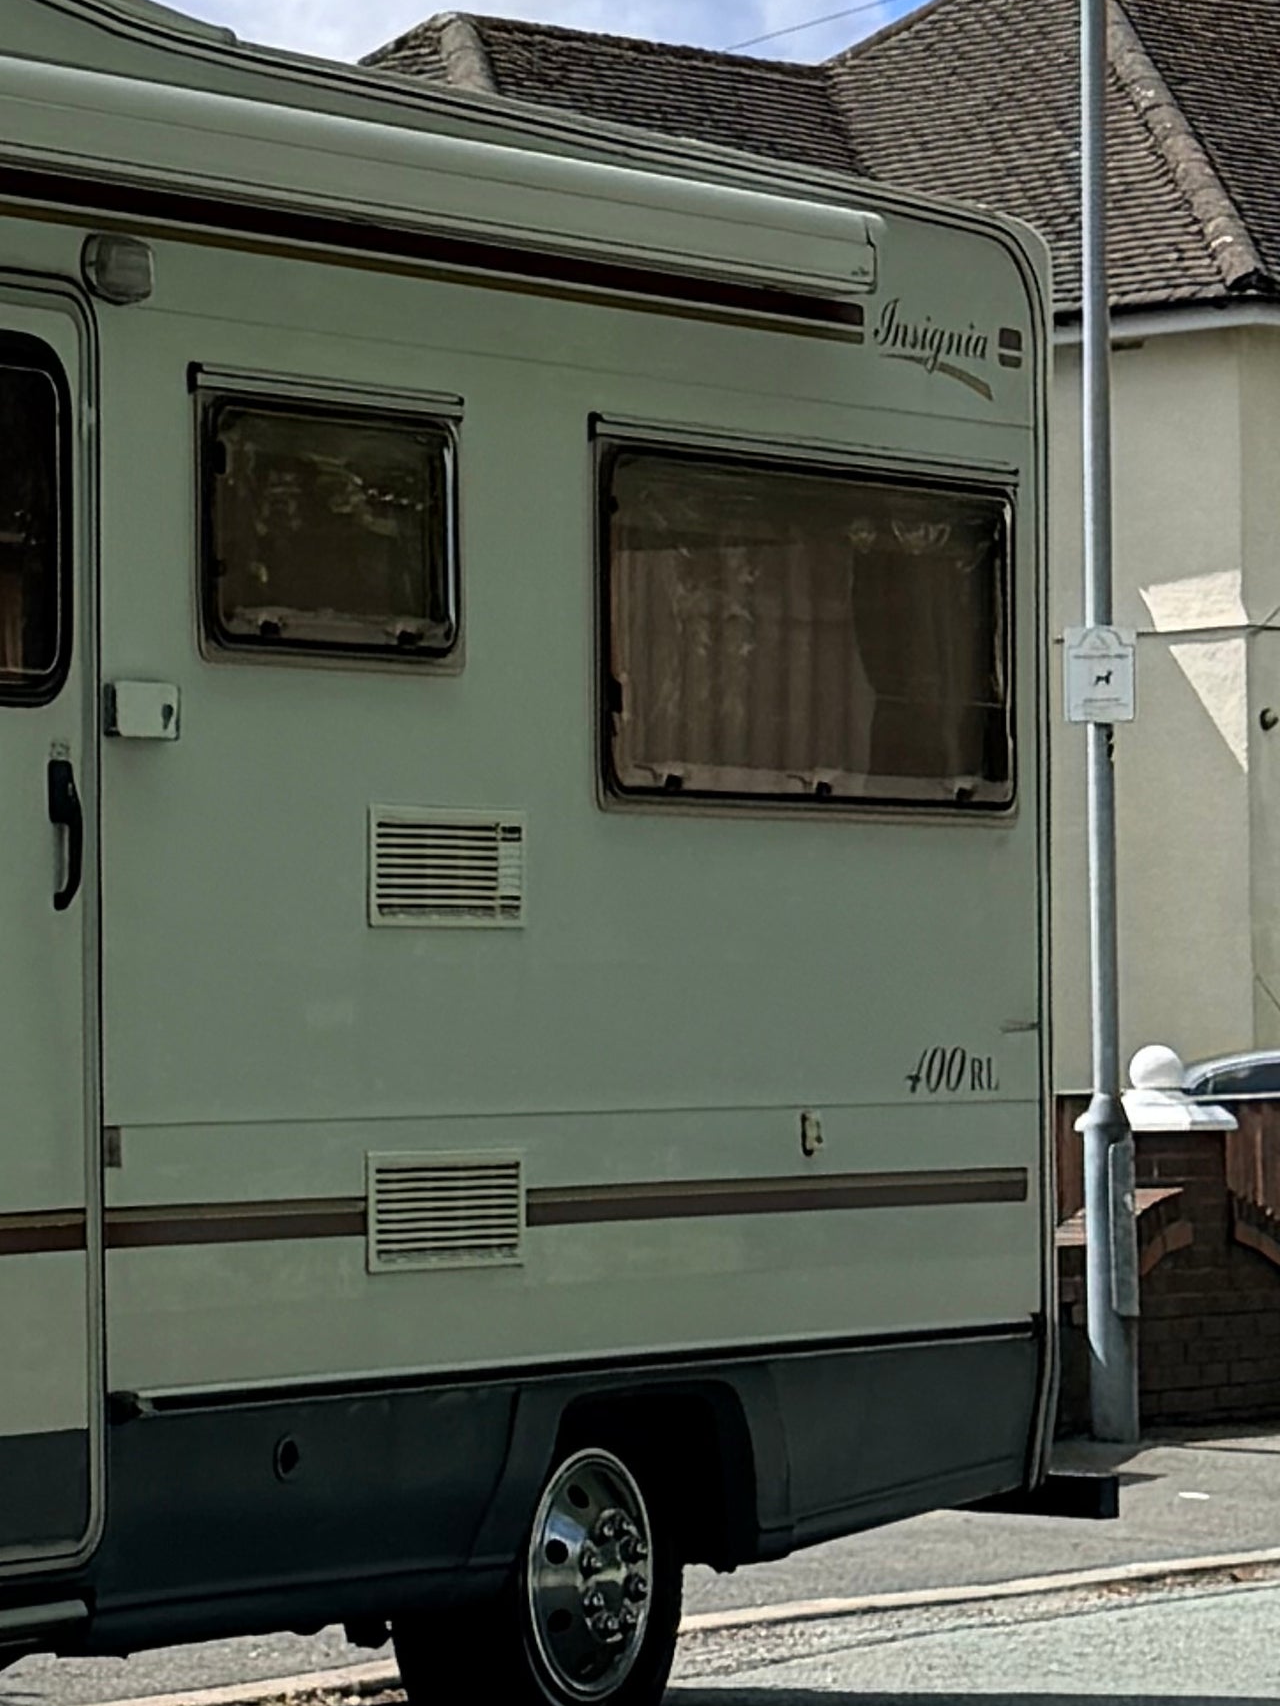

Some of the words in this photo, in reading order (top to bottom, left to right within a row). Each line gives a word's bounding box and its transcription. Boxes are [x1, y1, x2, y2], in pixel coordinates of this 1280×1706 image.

[873, 297, 989, 373] Insignia
[904, 1045, 967, 1094] 400
[970, 1056, 999, 1092] RL
